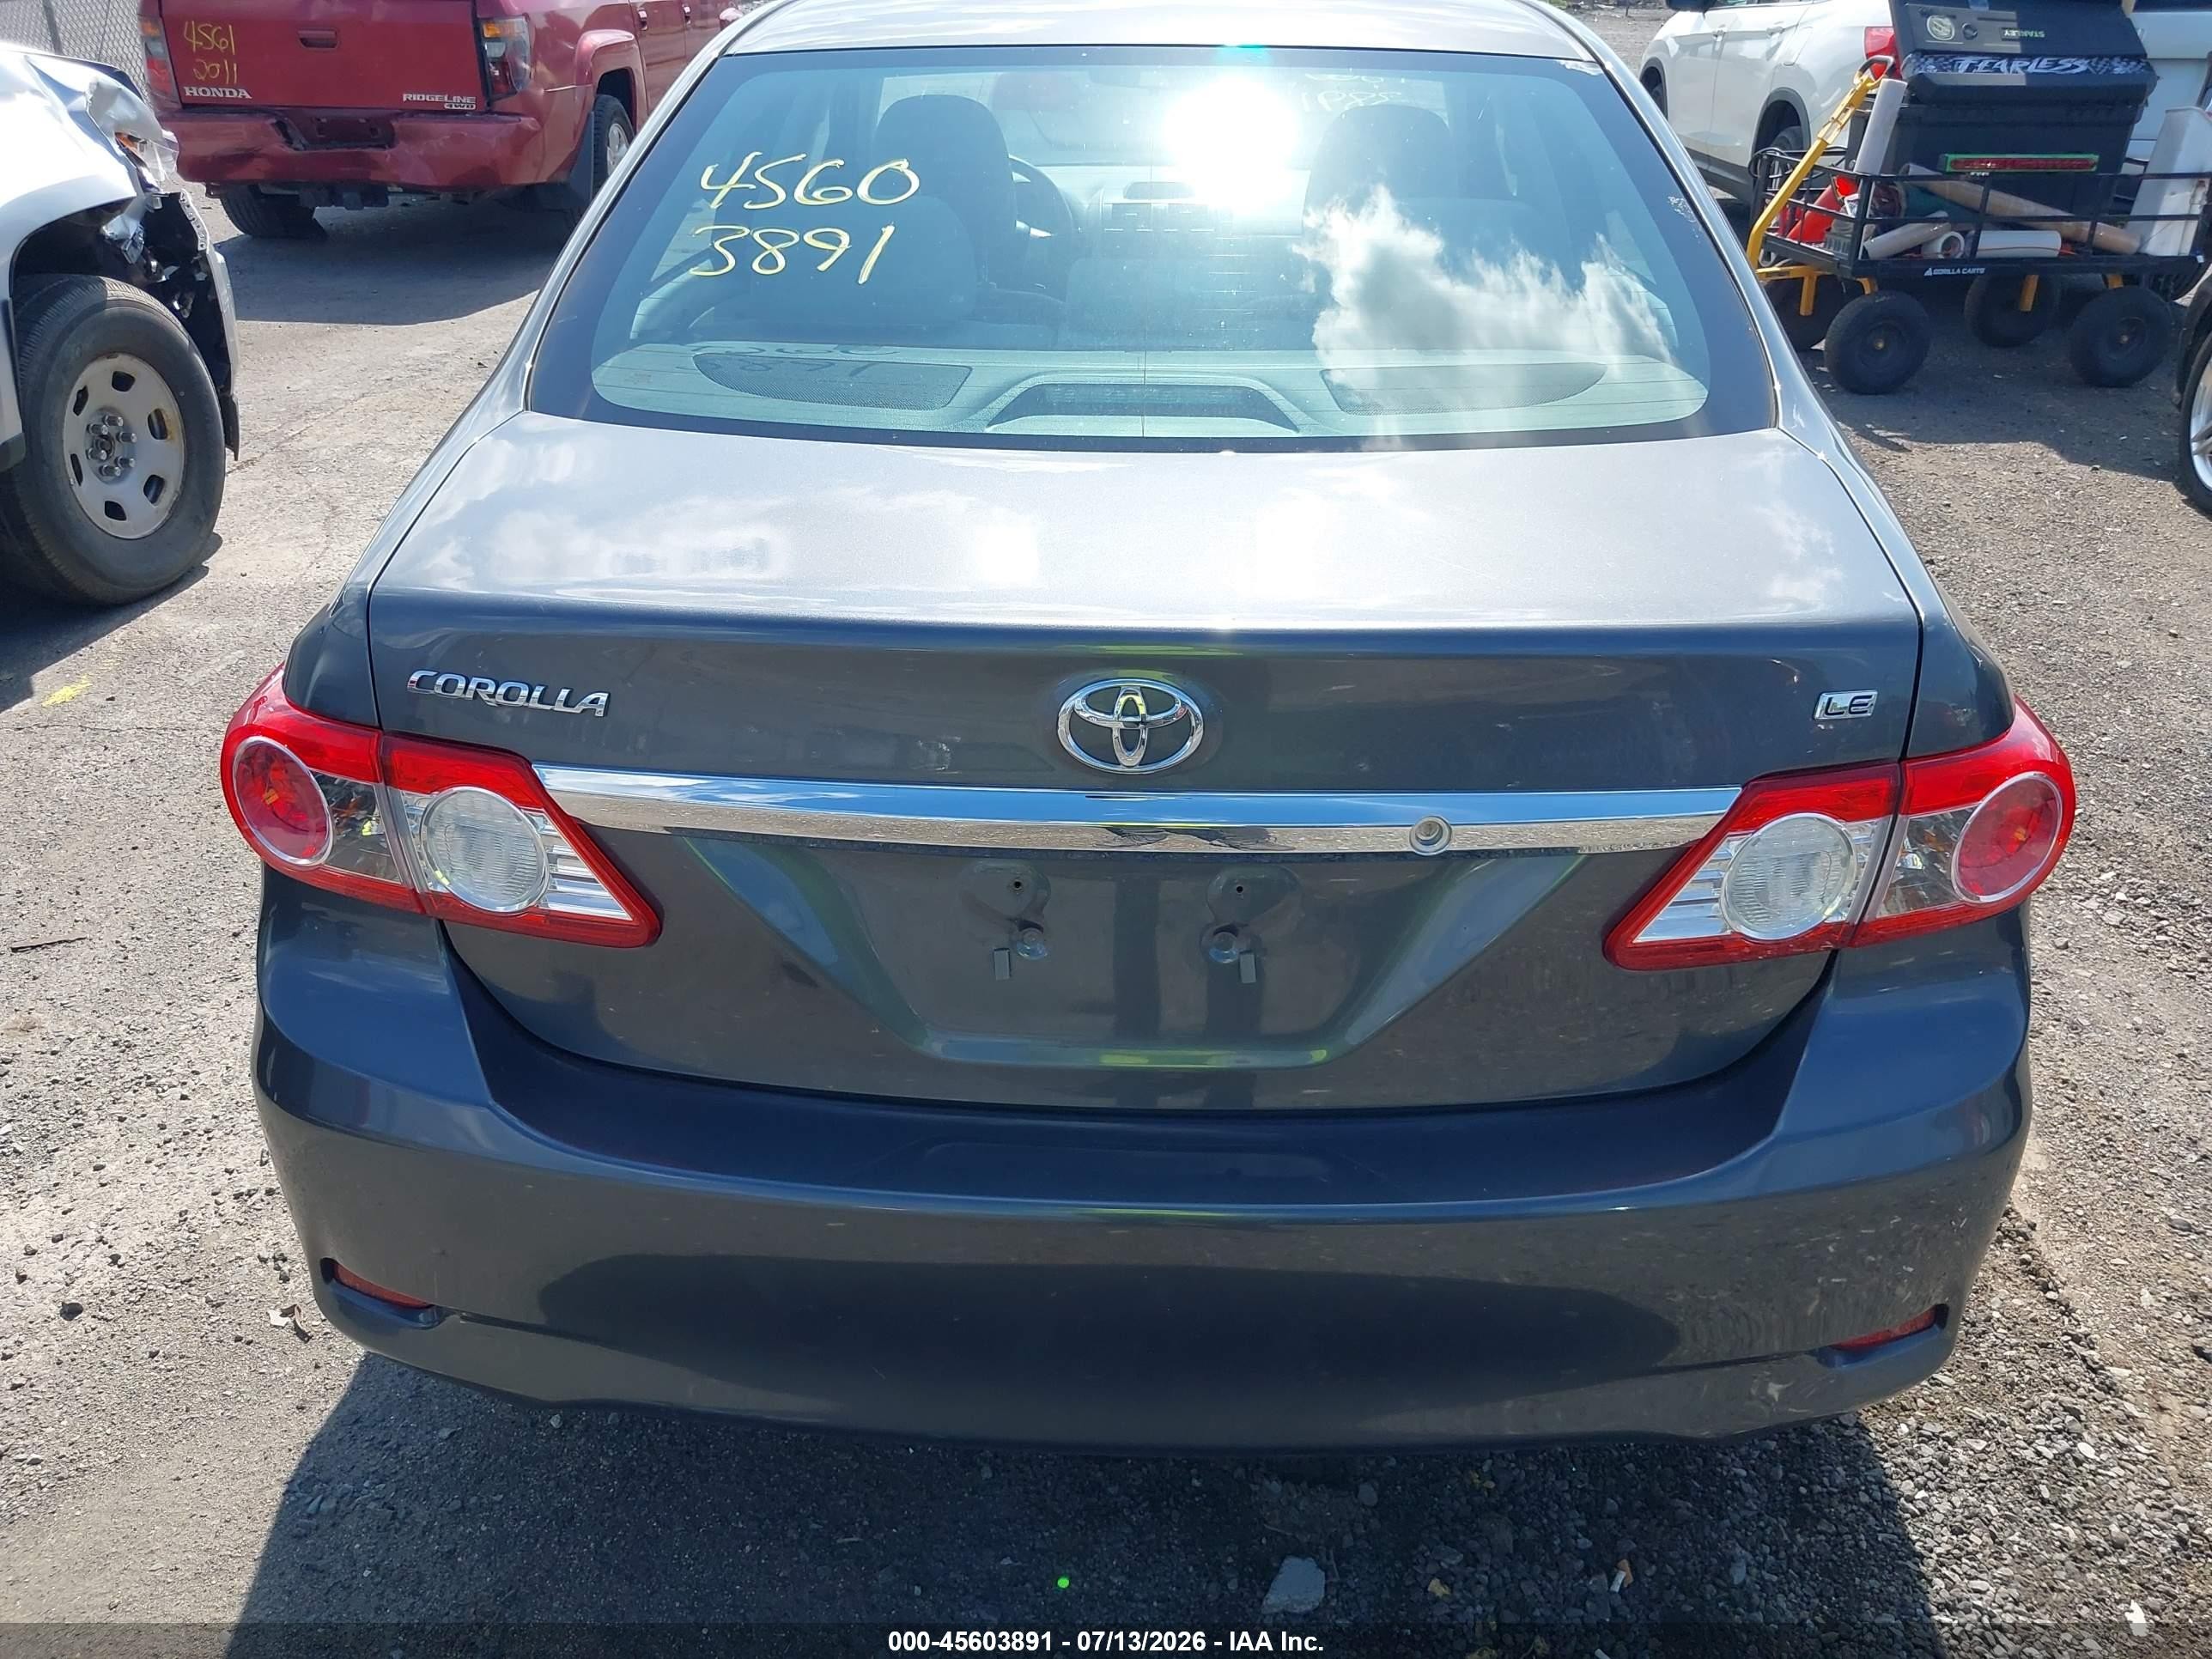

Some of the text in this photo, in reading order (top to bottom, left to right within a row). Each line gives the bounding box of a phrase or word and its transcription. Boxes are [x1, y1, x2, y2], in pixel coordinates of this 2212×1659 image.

[184, 20, 235, 56] 4561
[192, 58, 237, 84] 2011
[1953, 57, 2091, 75] FEARLESS
[183, 86, 253, 100] HONDA
[403, 93, 477, 104] RIDGELINE
[444, 102, 477, 111] 4WD
[700, 151, 921, 210] 4560
[689, 222, 896, 285] 3891
[406, 670, 611, 717] COROLLA
[1820, 693, 1875, 718] LE
